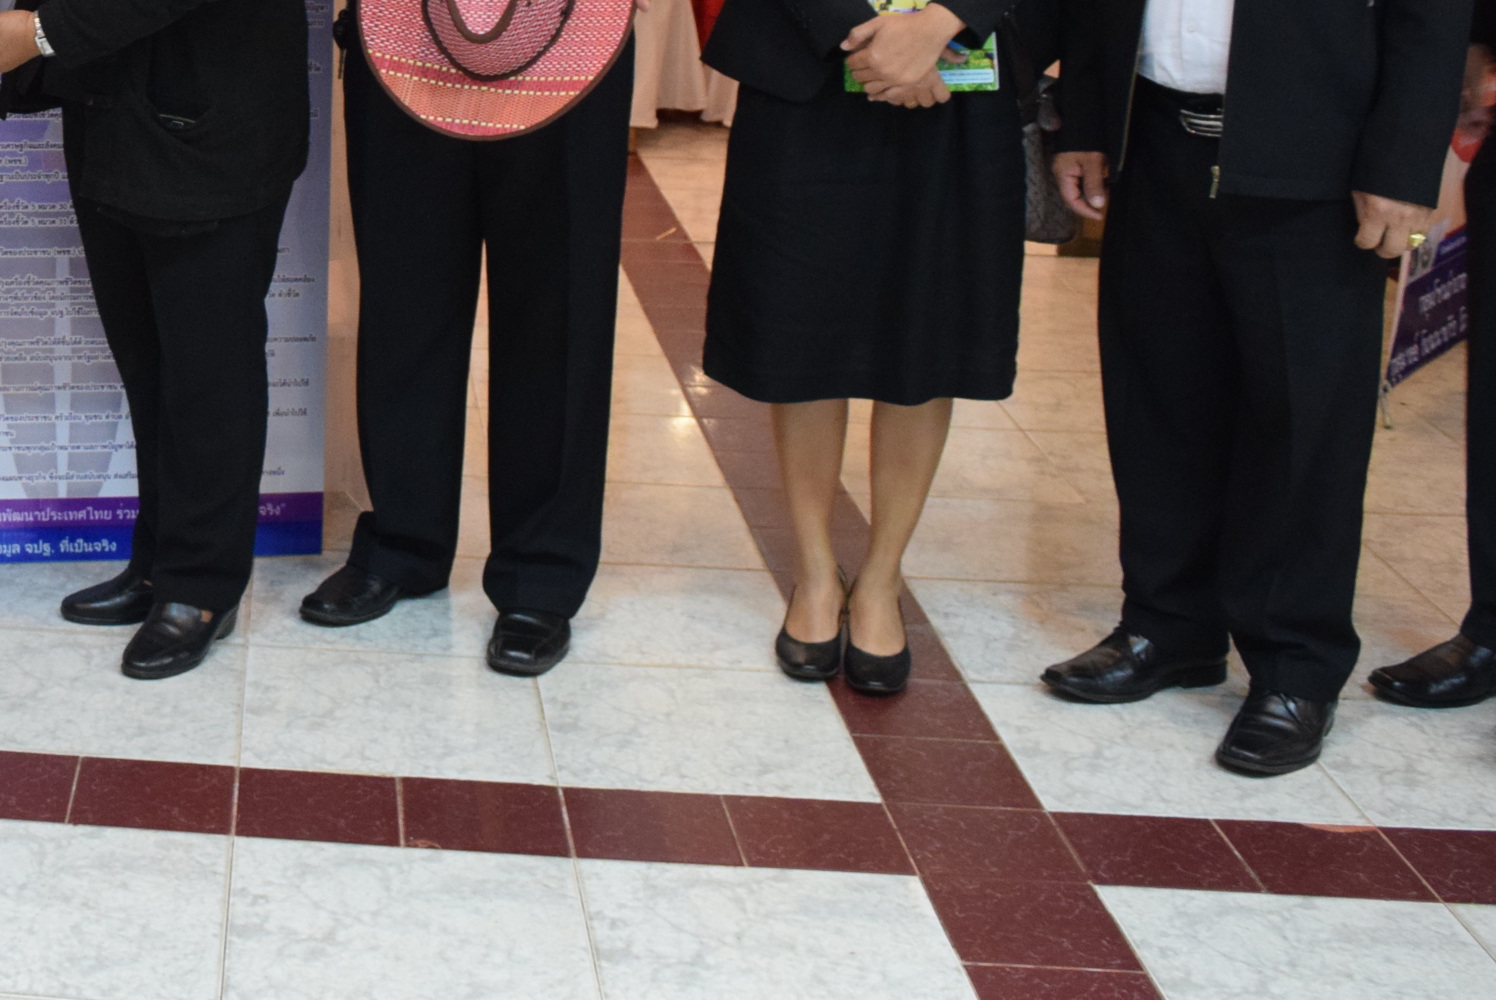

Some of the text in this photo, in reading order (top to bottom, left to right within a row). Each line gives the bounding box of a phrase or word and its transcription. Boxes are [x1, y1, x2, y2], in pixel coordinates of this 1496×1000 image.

[116, 502, 139, 519] ร่วม
[24, 539, 55, 557] จปฐ.
[59, 536, 117, 554] ที่เป็นจริง
